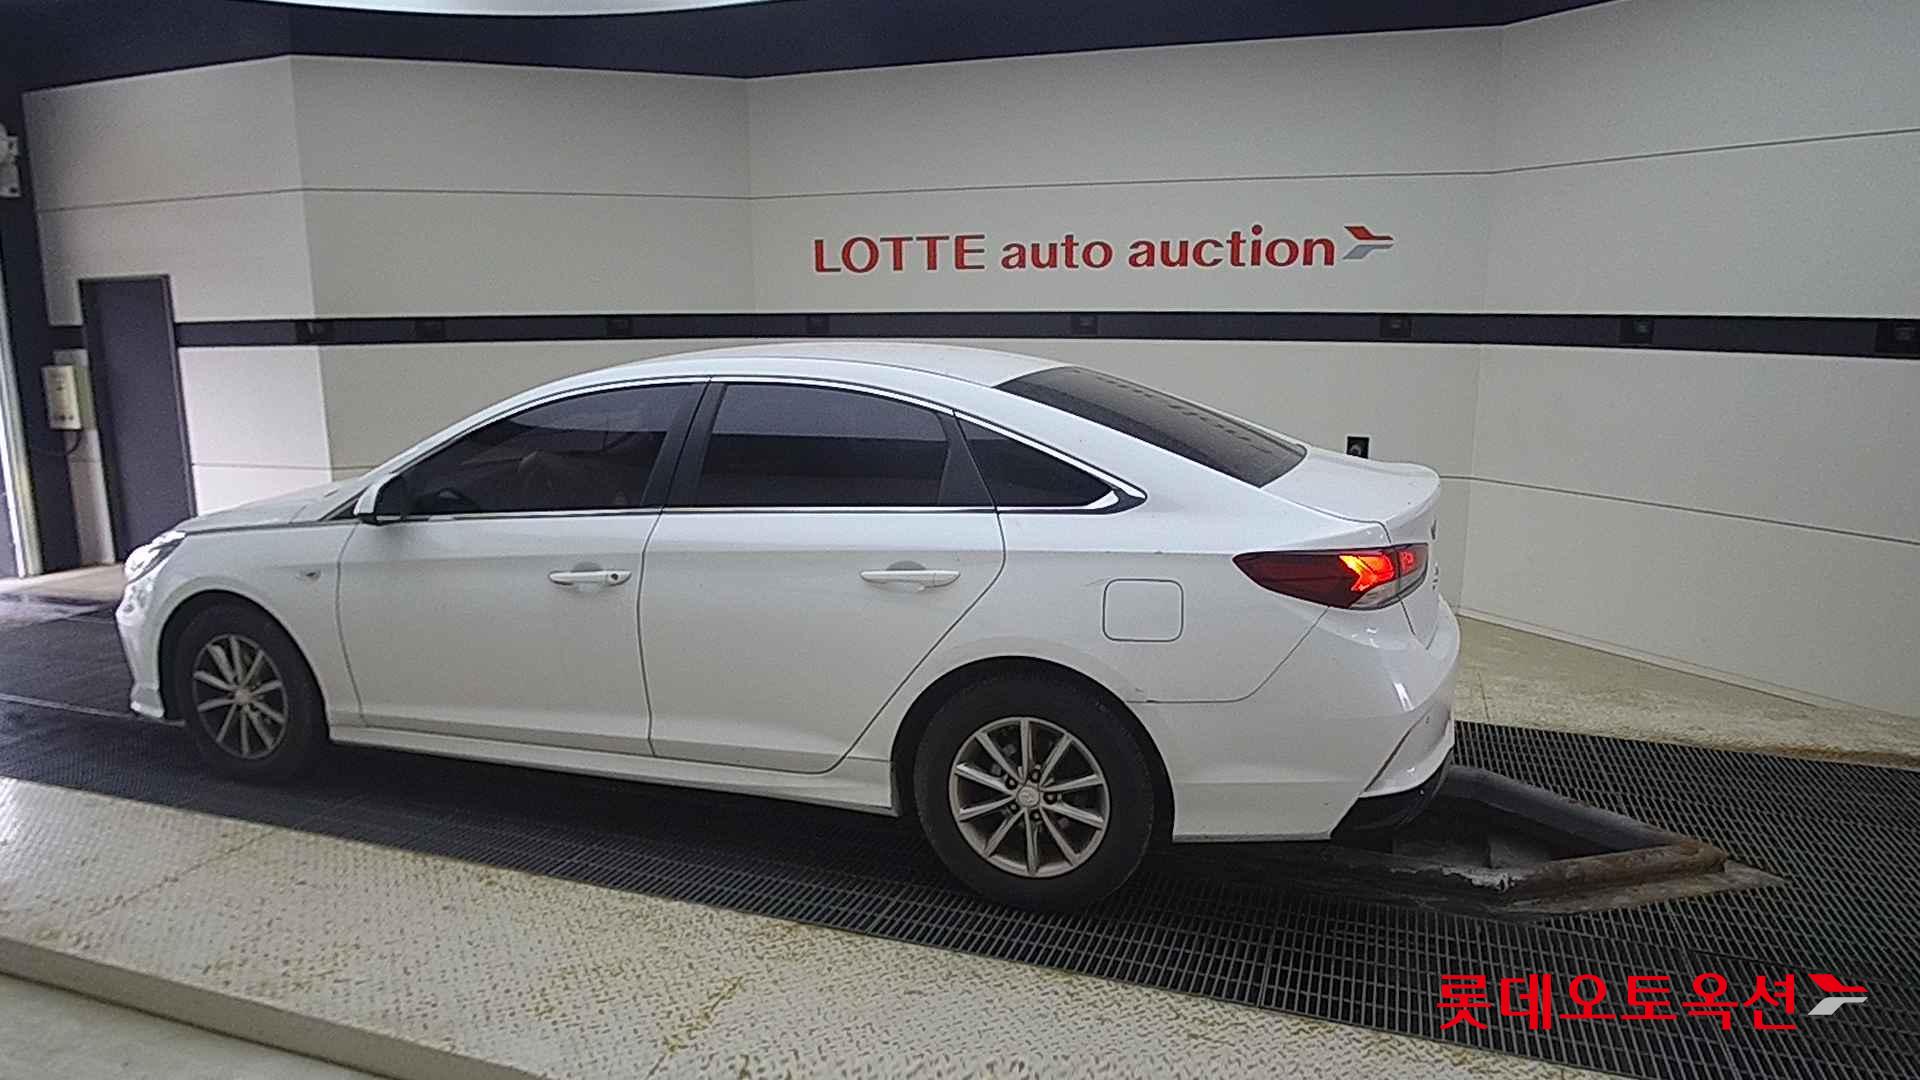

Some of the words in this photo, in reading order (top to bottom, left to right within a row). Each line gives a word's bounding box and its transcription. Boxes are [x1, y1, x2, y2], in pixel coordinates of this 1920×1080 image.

[814, 233, 986, 273] LOTTE
[1001, 234, 1114, 269] auto
[1127, 224, 1335, 268] auction
